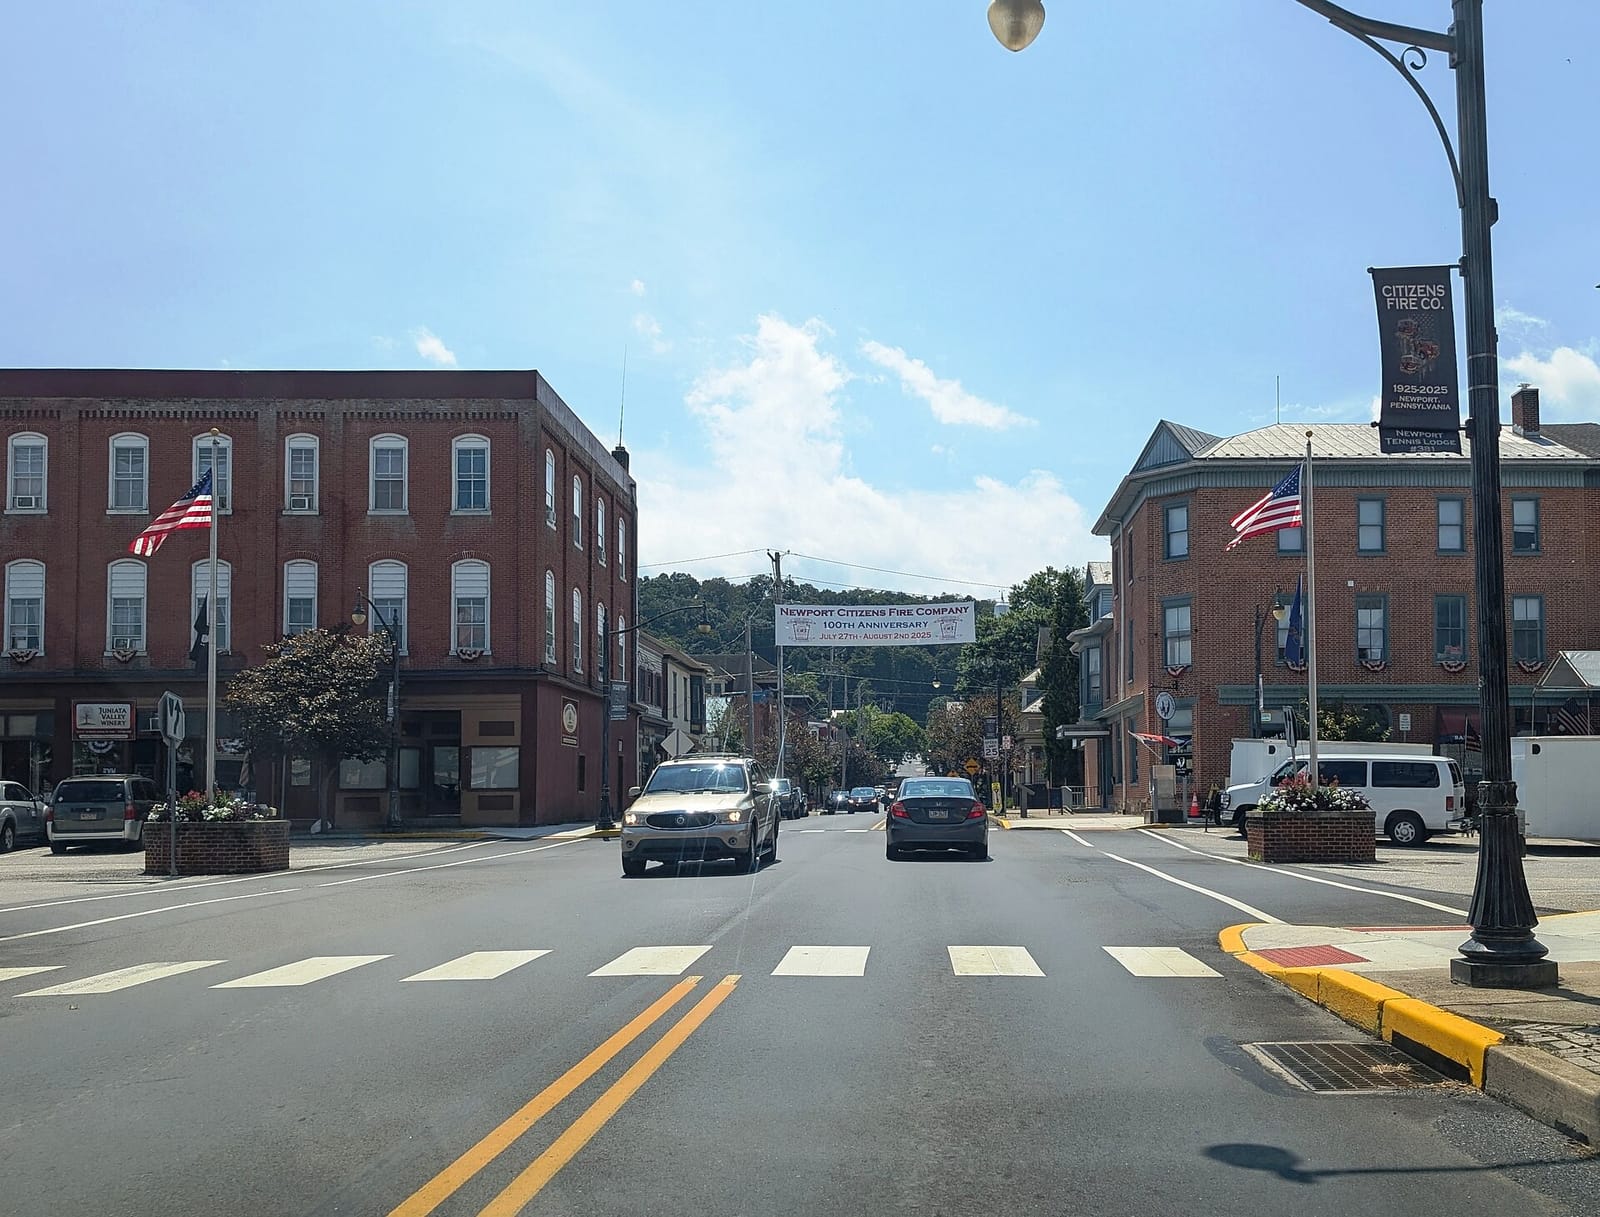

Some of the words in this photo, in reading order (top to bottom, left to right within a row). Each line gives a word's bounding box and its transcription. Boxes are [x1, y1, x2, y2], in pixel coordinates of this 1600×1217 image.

[1382, 284, 1446, 297] CITIZENS
[1386, 297, 1418, 310] FIRE
[1420, 297, 1445, 310] CO.
[1392, 384, 1449, 394] 1925-2025
[1389, 401, 1452, 411] PENNSYLVANIA
[1395, 429, 1444, 438] NEWPORT
[1423, 438, 1457, 446] LODGE
[780, 607, 835, 617] NEWPORT
[837, 608, 886, 617] CITIZENS
[888, 608, 914, 617] FIRE
[916, 606, 970, 616] COMPANY
[823, 621, 855, 629] 100TH
[857, 621, 929, 629] ANNIVERSARY
[893, 632, 910, 640] 2ND
[911, 631, 932, 639] 2025
[985, 748, 998, 756] 25
